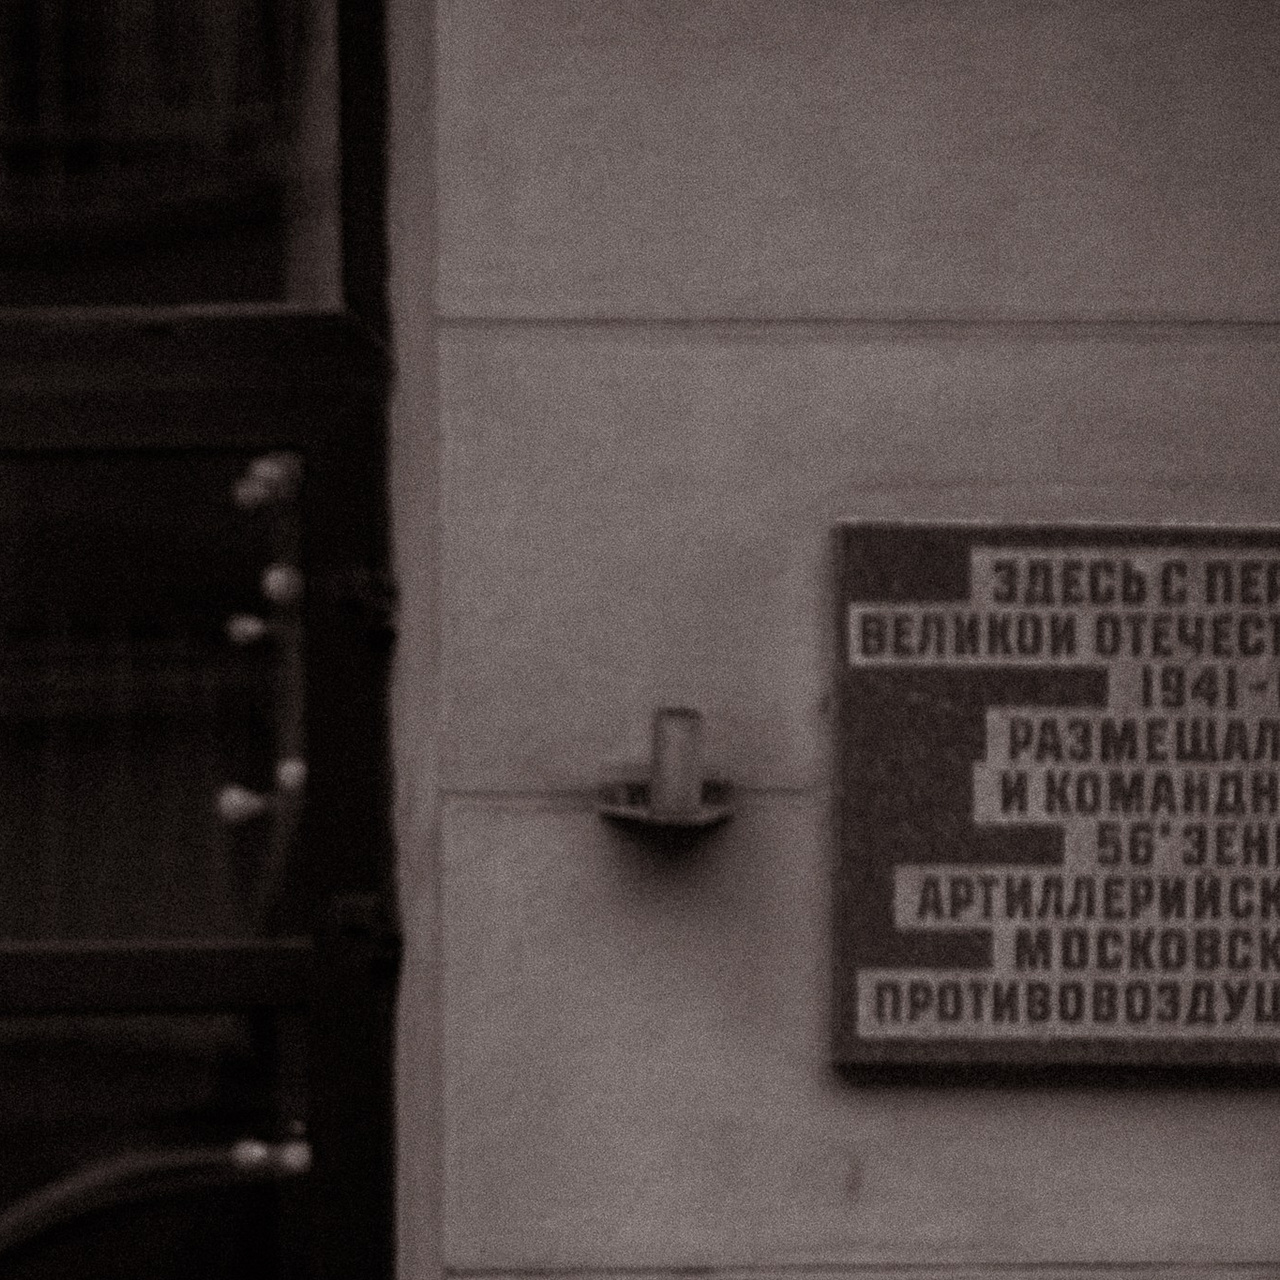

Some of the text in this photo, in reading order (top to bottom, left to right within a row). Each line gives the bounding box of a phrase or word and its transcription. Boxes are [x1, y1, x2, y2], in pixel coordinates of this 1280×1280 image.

[992, 559, 1147, 604] ЗДЕСЬ
[1161, 560, 1187, 604] С
[1001, 769, 1278, 816] И КОМАНДН
[1182, 822, 1280, 866] ЗЕН
[1016, 927, 1280, 970] МОСКОВСК
